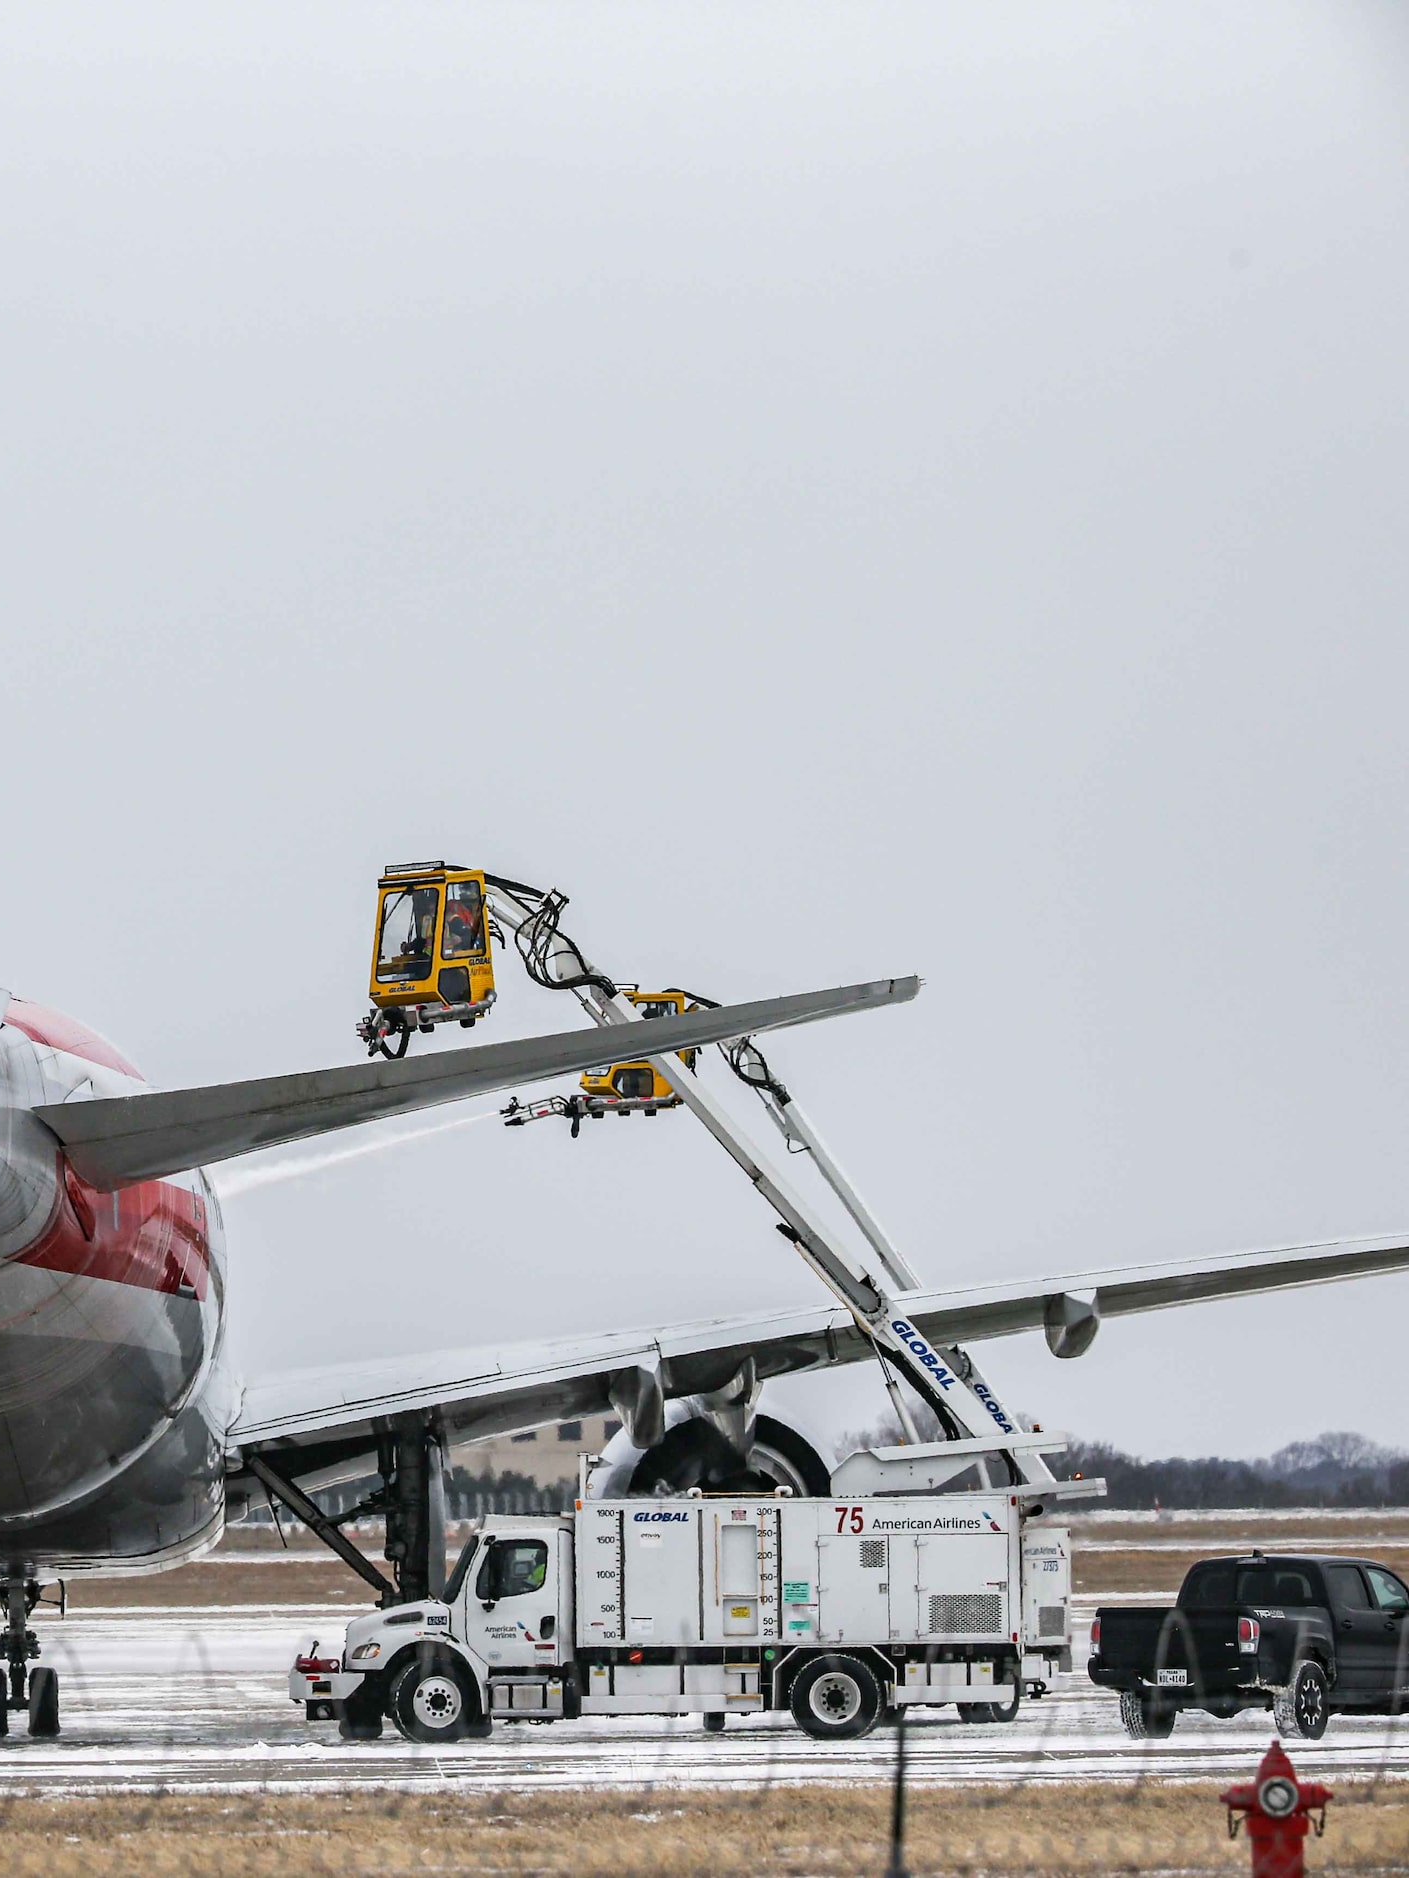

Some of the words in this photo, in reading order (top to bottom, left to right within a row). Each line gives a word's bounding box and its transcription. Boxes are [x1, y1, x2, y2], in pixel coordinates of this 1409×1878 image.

[389, 985, 415, 993] GLOBAL
[892, 1320, 956, 1391] GLOBAL
[973, 1383, 1014, 1434] GLOBA
[596, 1509, 615, 1517] 1900
[756, 1507, 773, 1516] 300
[633, 1512, 690, 1522] GLOBAL
[835, 1507, 864, 1534] 75
[872, 1518, 932, 1530] American
[933, 1517, 981, 1529] Airlines
[757, 1529, 773, 1538] 250
[596, 1536, 615, 1544] 1500
[757, 1551, 773, 1560] 200
[596, 1570, 616, 1579] 1000
[759, 1573, 773, 1581] 150
[759, 1595, 773, 1603] 100
[600, 1604, 616, 1612] 500
[763, 1617, 773, 1625] 50
[485, 1625, 516, 1633] American
[603, 1631, 616, 1639] 100
